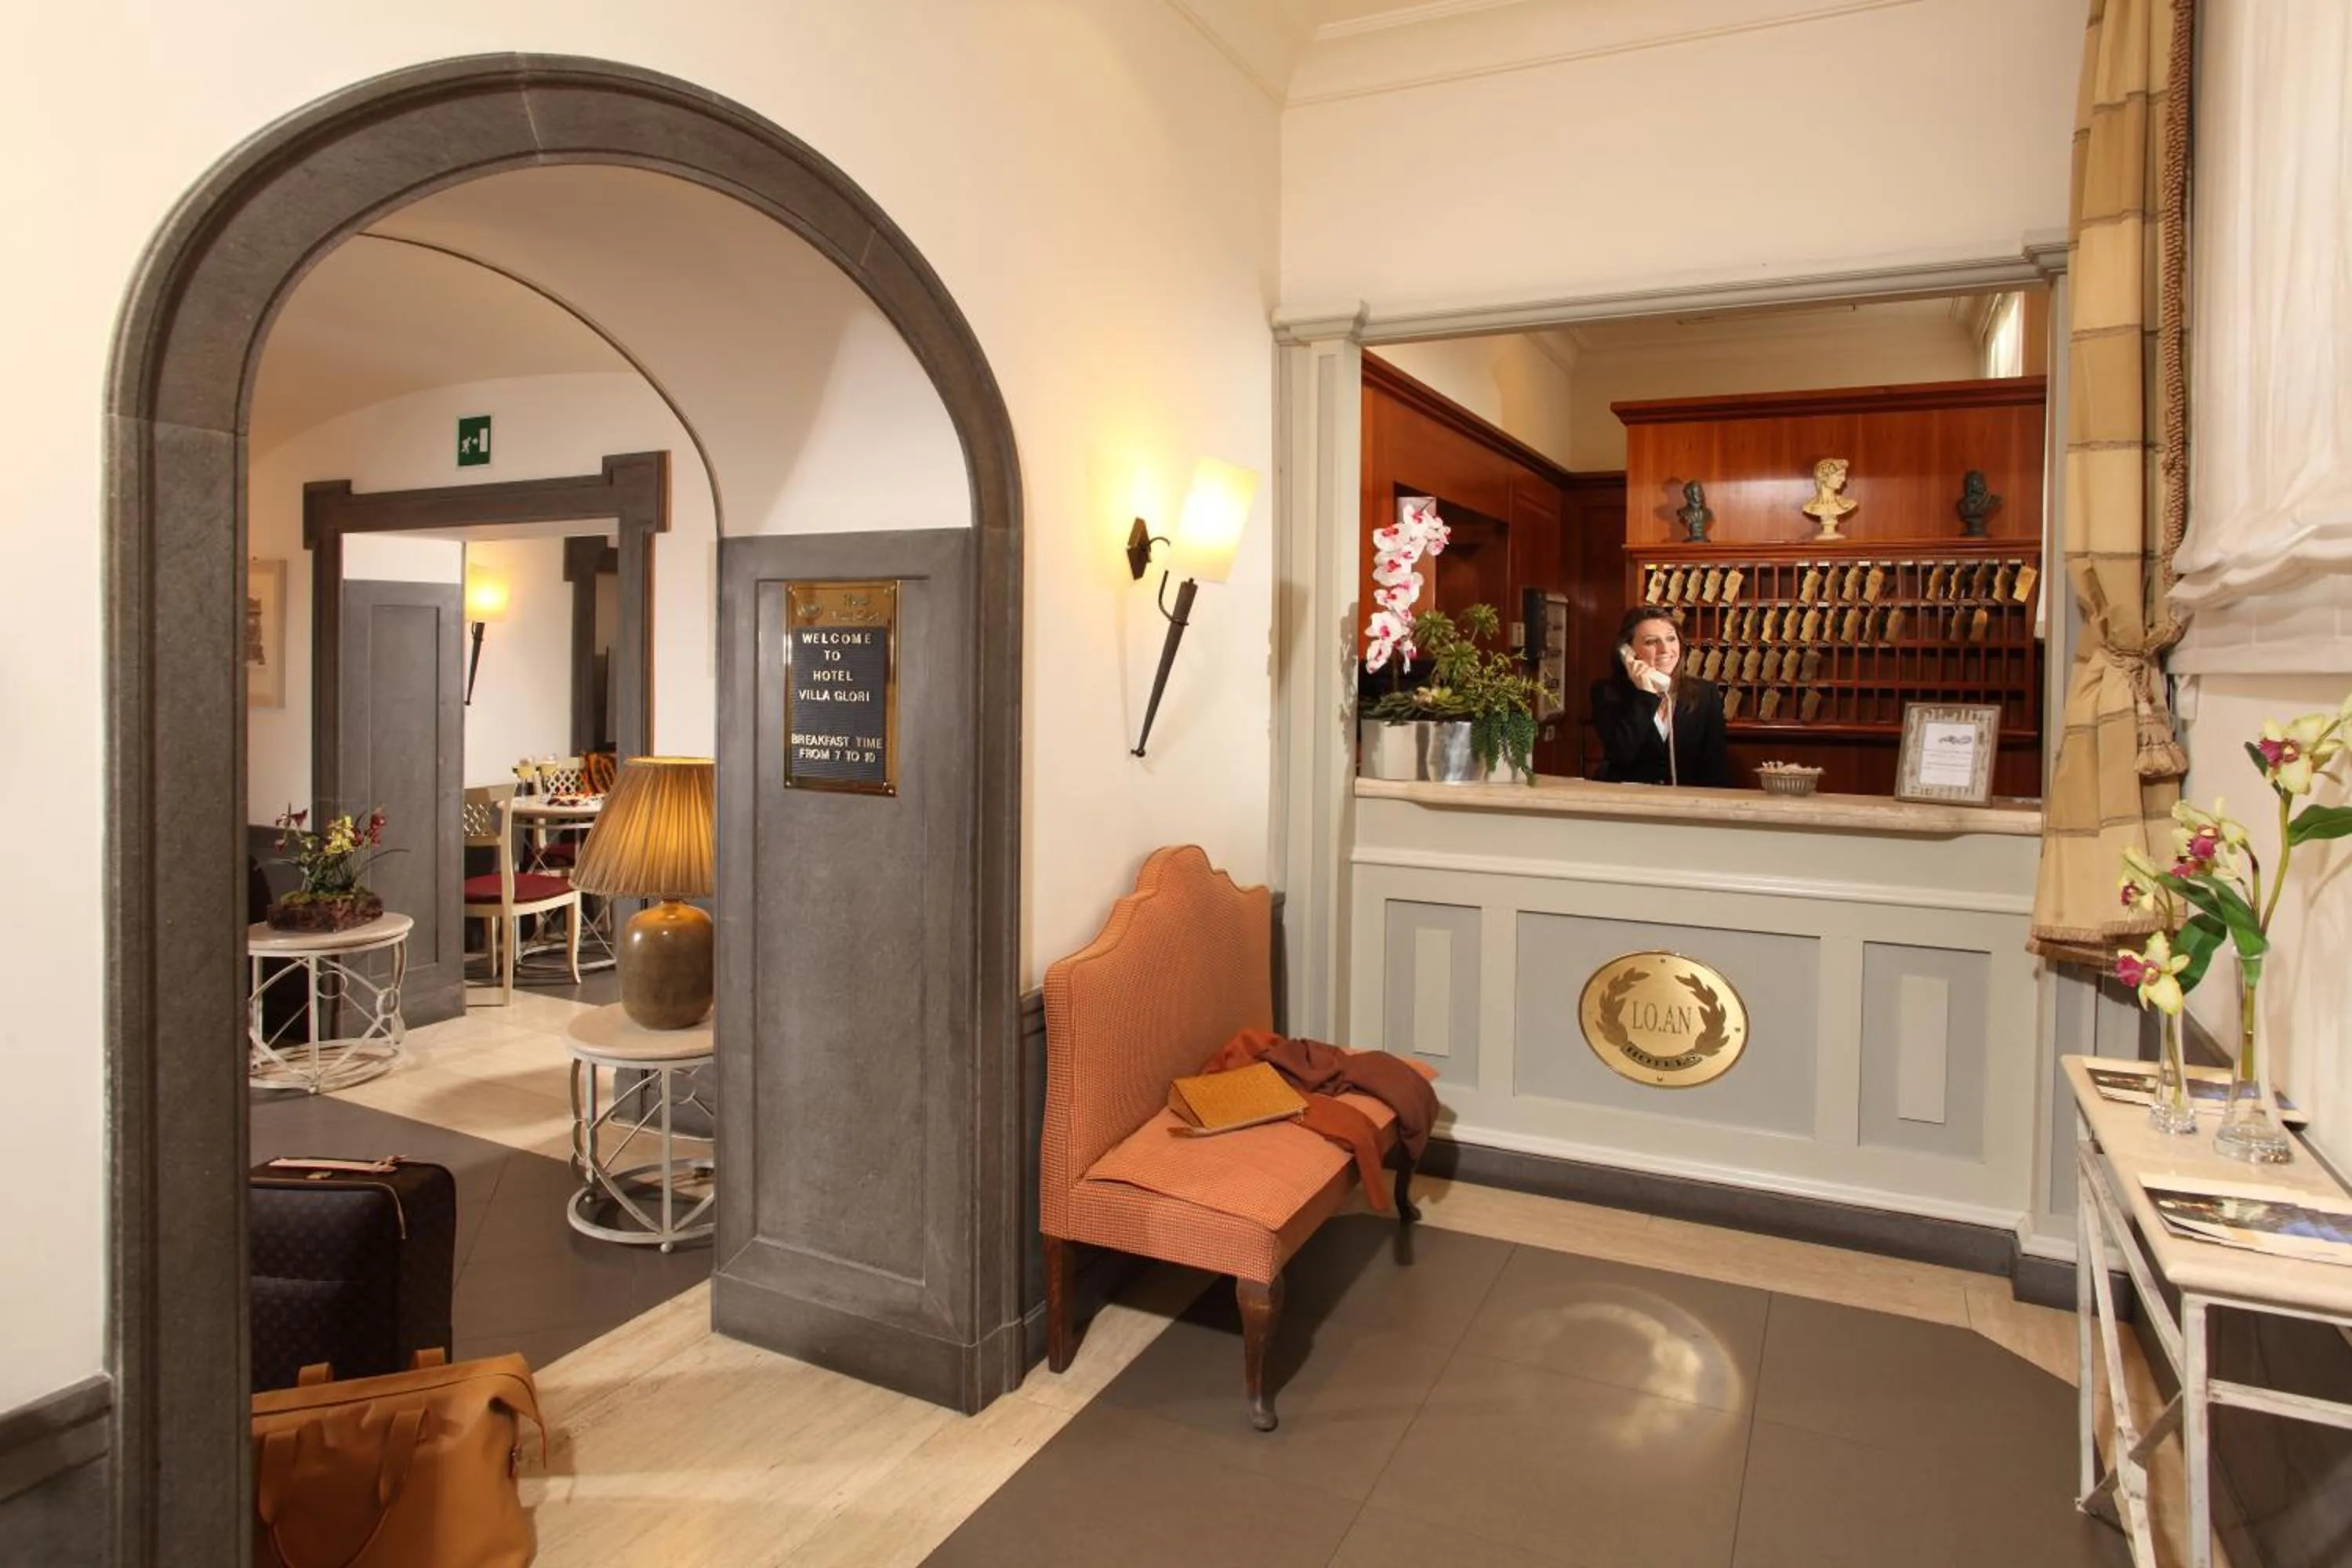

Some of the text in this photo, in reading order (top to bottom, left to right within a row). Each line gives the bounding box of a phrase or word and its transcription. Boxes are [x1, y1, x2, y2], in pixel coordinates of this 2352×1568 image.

[802, 633, 872, 644] WELCOME
[824, 650, 841, 661] TO
[813, 670, 853, 681] HOTEL
[799, 689, 869, 702] VILLA GLORI
[791, 734, 883, 749] BREAKFAST TIME
[800, 748, 830, 760] FROM
[835, 750, 841, 760] 7
[845, 750, 860, 762] TO
